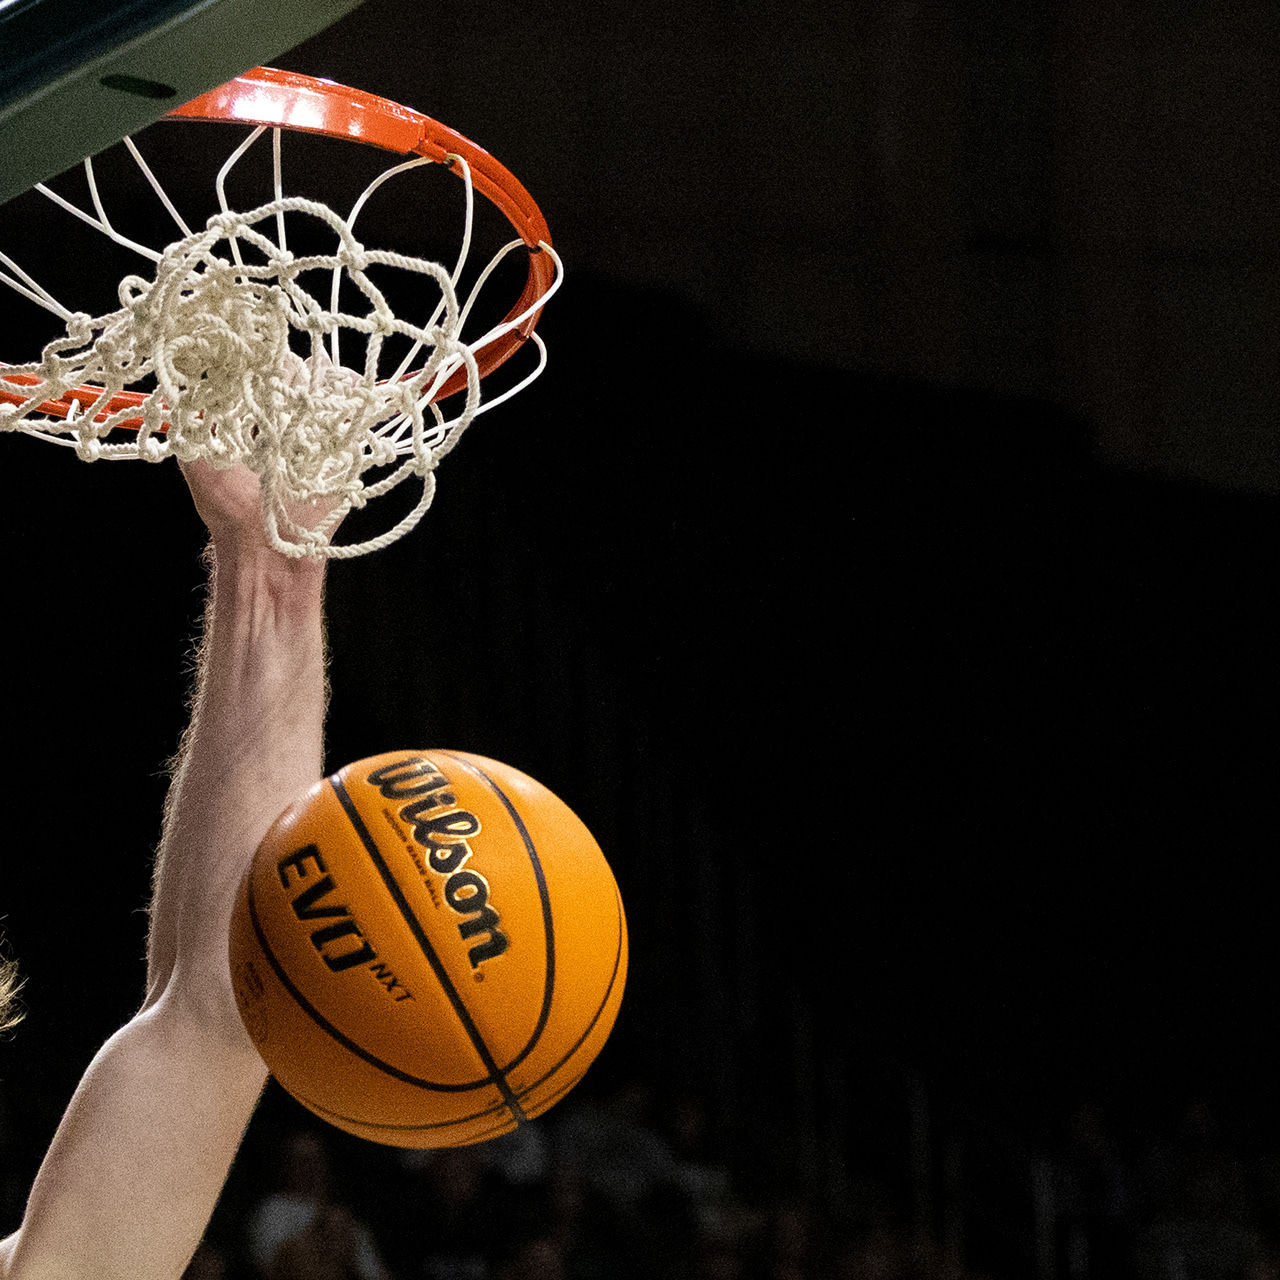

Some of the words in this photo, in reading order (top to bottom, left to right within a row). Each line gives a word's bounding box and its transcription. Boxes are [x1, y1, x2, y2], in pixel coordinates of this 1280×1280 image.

[276, 843, 378, 974] EVO
[369, 962, 416, 1003] NXT
[367, 756, 510, 970] Wilson
